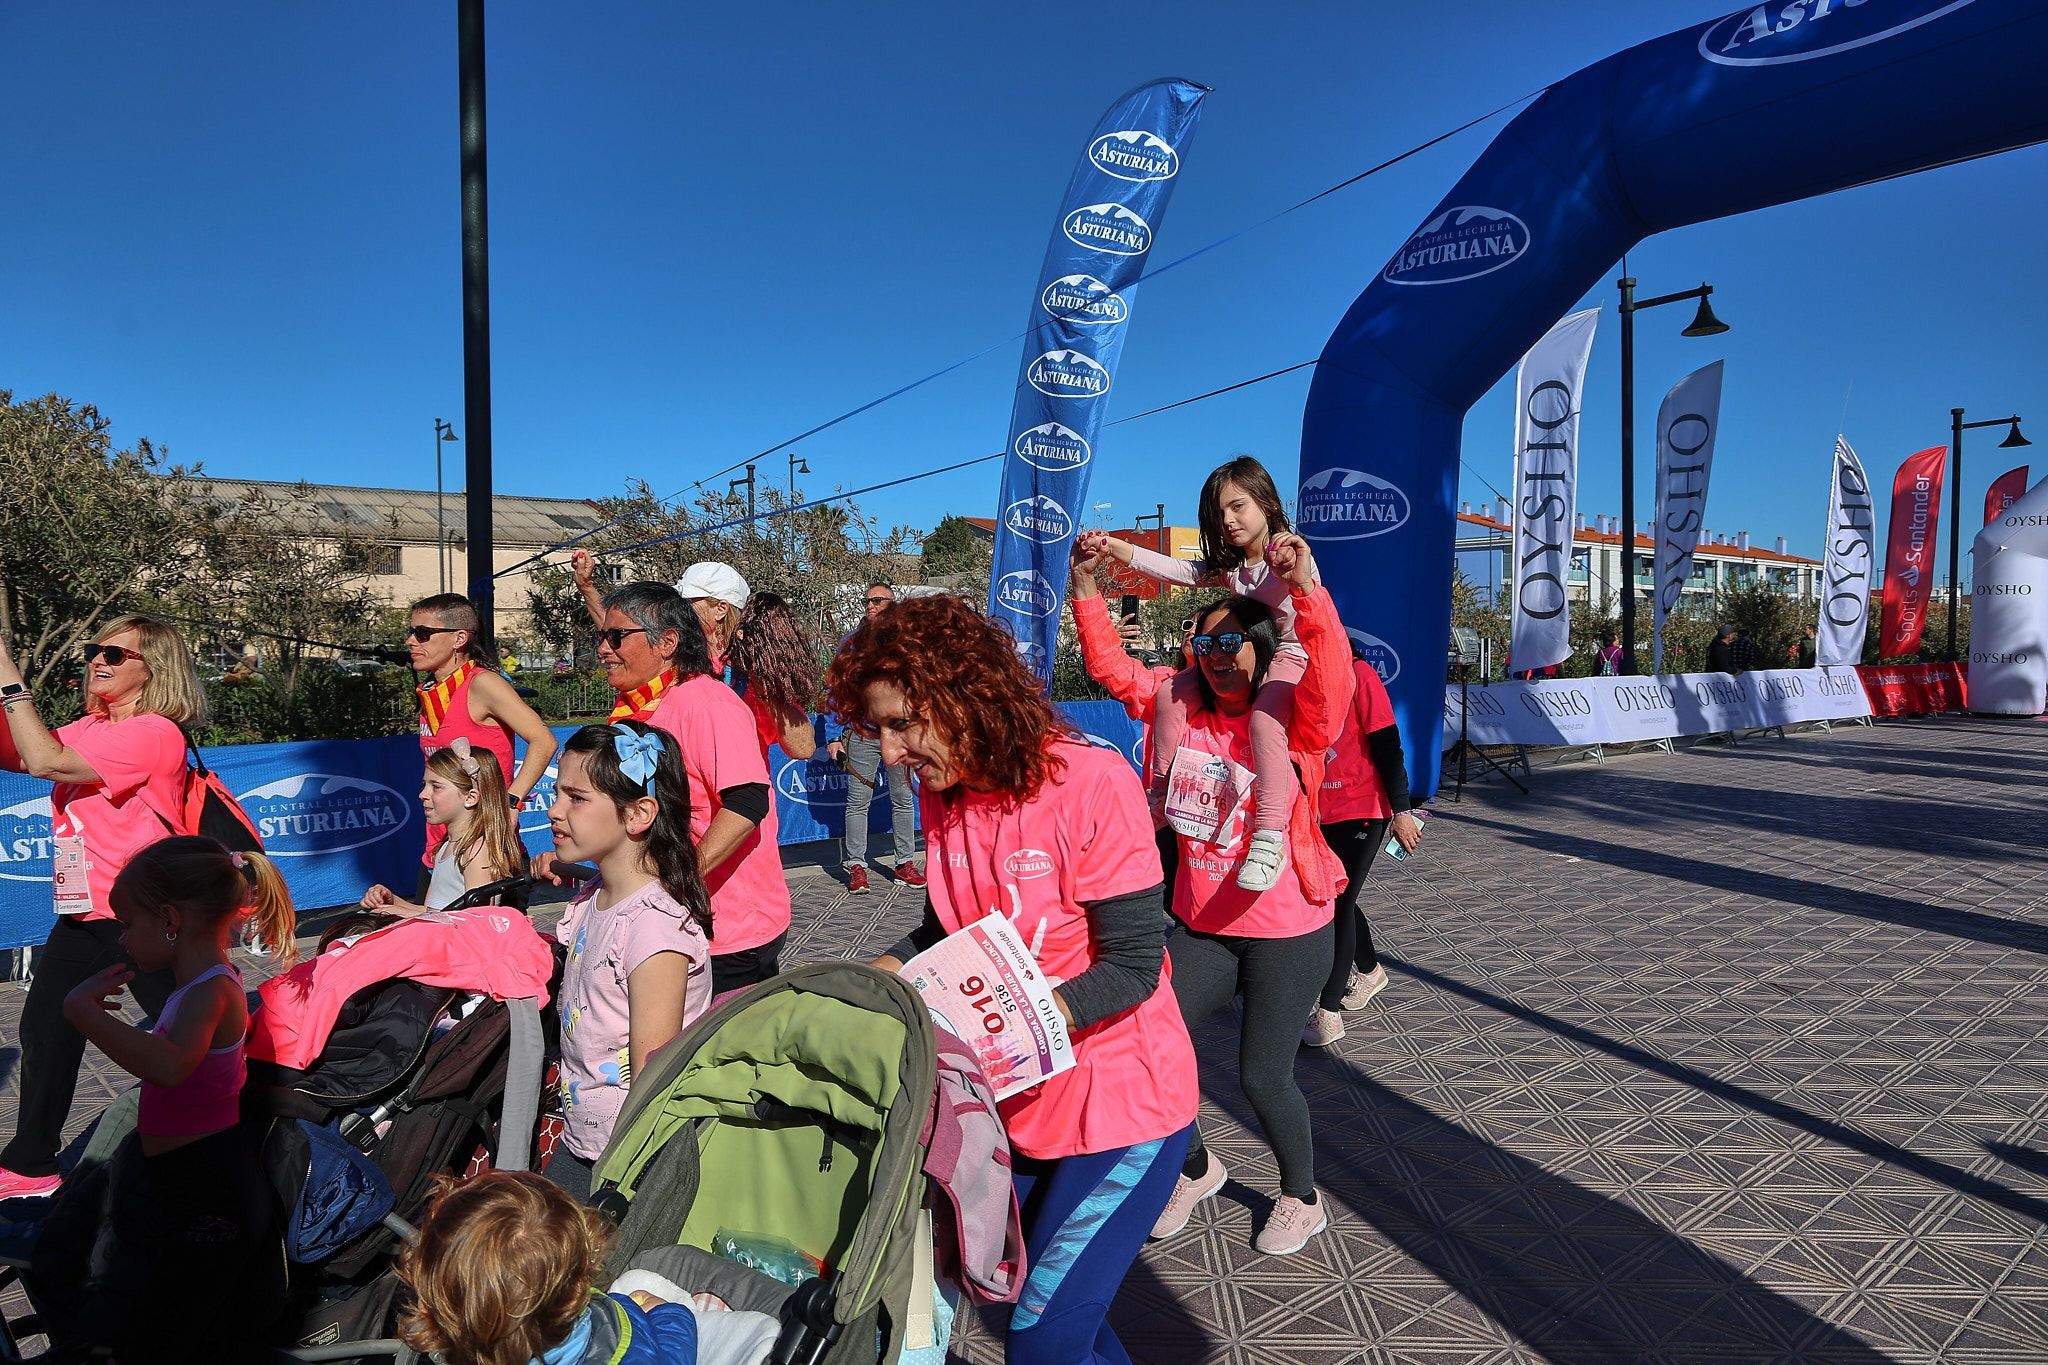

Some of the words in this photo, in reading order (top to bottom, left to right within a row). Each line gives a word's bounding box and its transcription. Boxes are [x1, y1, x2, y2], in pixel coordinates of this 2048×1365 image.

[1068, 214, 1144, 250] ASTURIANA
[1458, 221, 1511, 237] LECHERA
[1389, 234, 1518, 276] ASTURIANA
[1033, 363, 1100, 392] ASTURIANA
[1020, 436, 1081, 462] ASTURIANA
[1344, 492, 1394, 500] LECHERA
[1520, 380, 1571, 620] OYSHO
[1906, 474, 1930, 562] Santander
[1827, 466, 1872, 626] OYSHO
[1976, 584, 2032, 596] OYSHO
[1897, 590, 1918, 642] Sports
[1973, 652, 2028, 664] OYSHO
[1614, 684, 1676, 712] OYSHO
[1696, 680, 1746, 706] OYSHO
[1758, 676, 1804, 702] OYSHO
[1520, 690, 1591, 718] OYSHO
[1322, 781, 1342, 789] MUJER
[258, 802, 322, 814] CENTRAL
[259, 805, 398, 838] STURIANA
[1172, 820, 1200, 832] OYSHO
[996, 930, 1028, 970] Santander
[1004, 971, 1023, 997] MUJER
[959, 976, 1005, 1034] 016
[996, 984, 1016, 1013] 5136
[1020, 1000, 1031, 1010] LA
[1024, 1010, 1036, 1020] DE
[1038, 998, 1064, 1051] OYSHO
[1030, 1020, 1048, 1056] CARRERA
[584, 1116, 600, 1128] day
